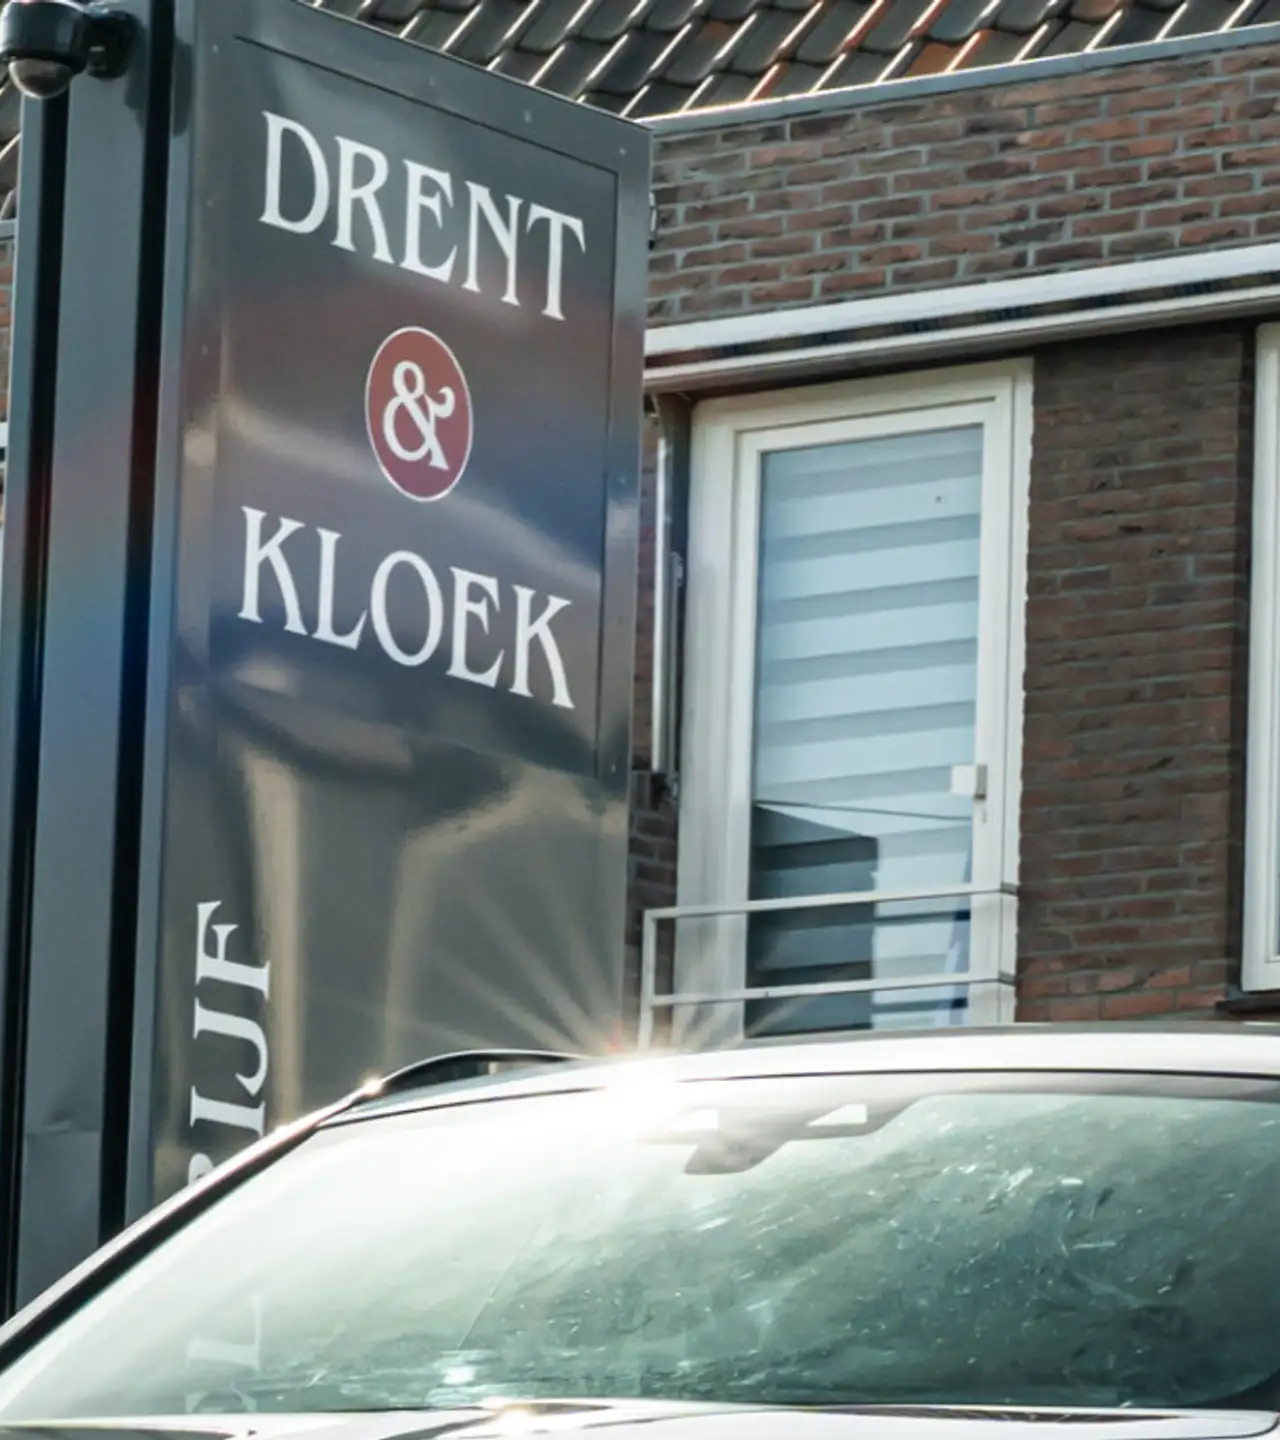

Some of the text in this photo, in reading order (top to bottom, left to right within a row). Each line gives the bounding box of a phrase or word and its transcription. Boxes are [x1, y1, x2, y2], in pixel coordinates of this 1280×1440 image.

[259, 111, 586, 320] DRENT
[382, 359, 457, 471] &
[237, 506, 575, 709] KLOEK
[188, 901, 271, 1186] IJF
